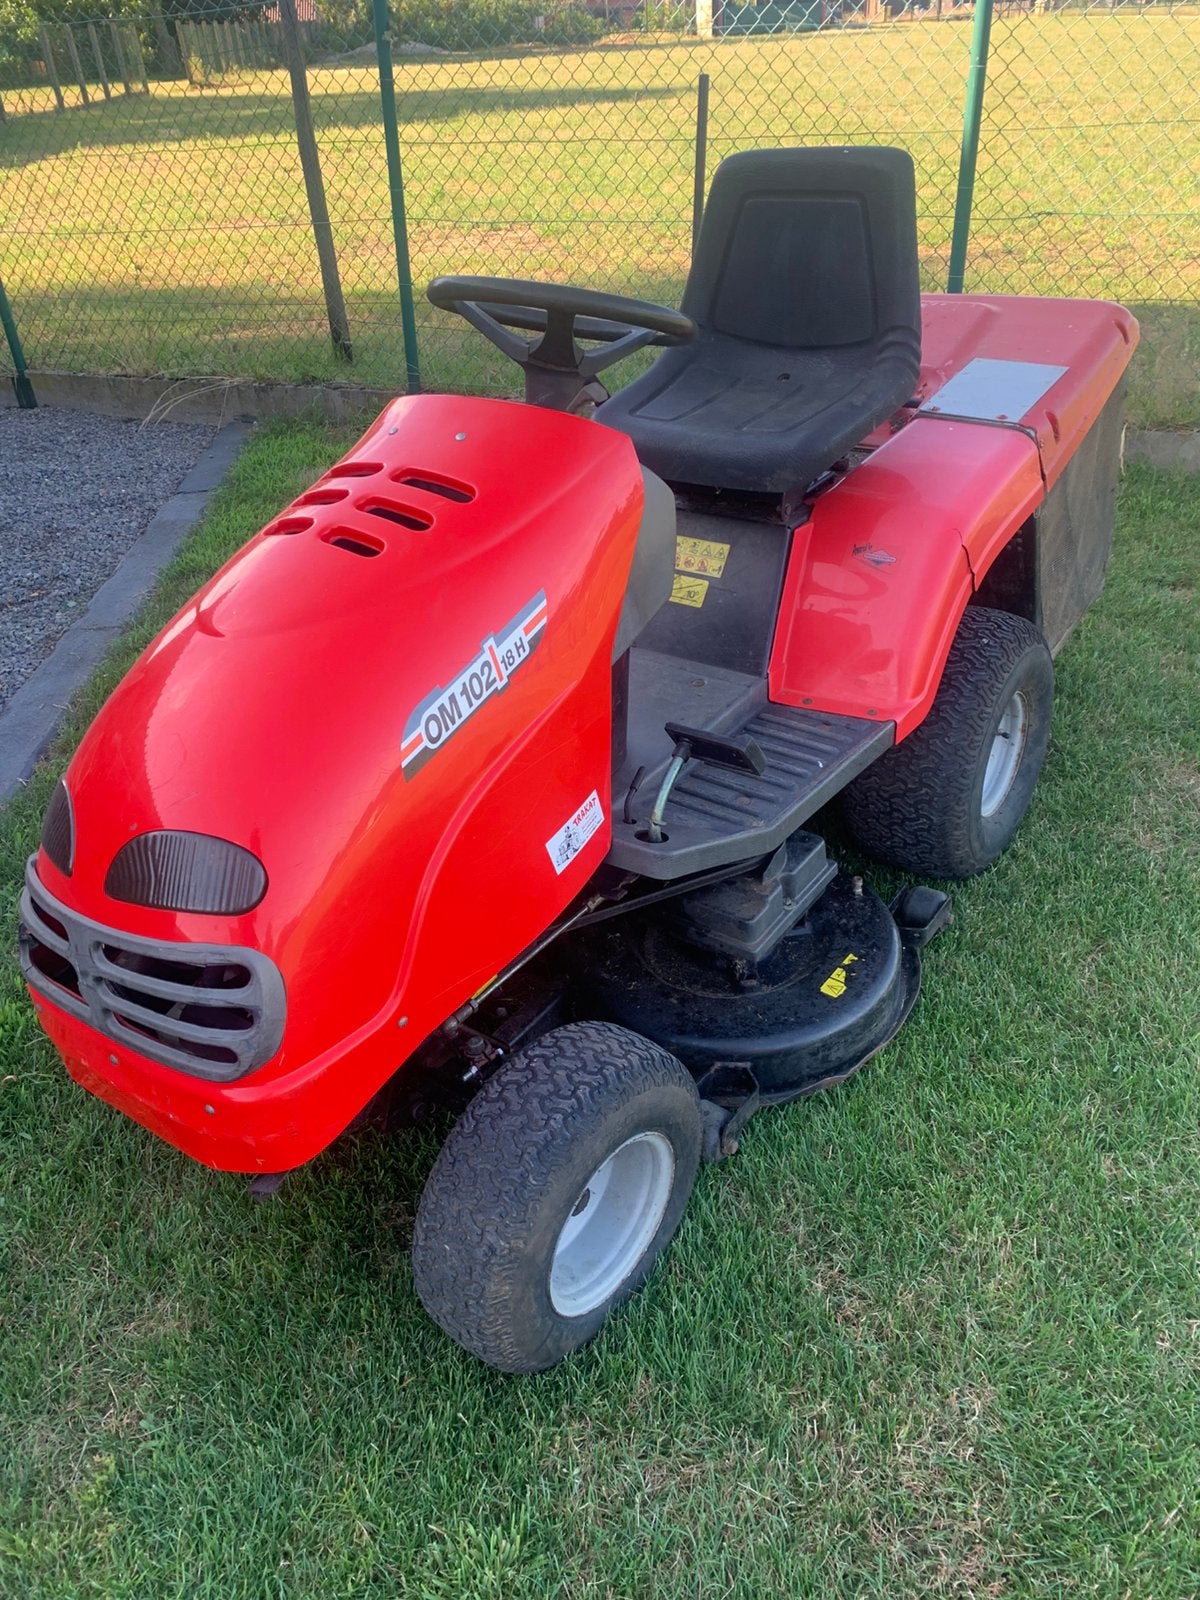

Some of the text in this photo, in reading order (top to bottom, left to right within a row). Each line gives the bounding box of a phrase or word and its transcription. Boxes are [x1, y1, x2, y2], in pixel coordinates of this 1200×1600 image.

[500, 637, 527, 672] 18 H
[424, 660, 497, 745] OM 102
[572, 797, 597, 827] TRAKAT
